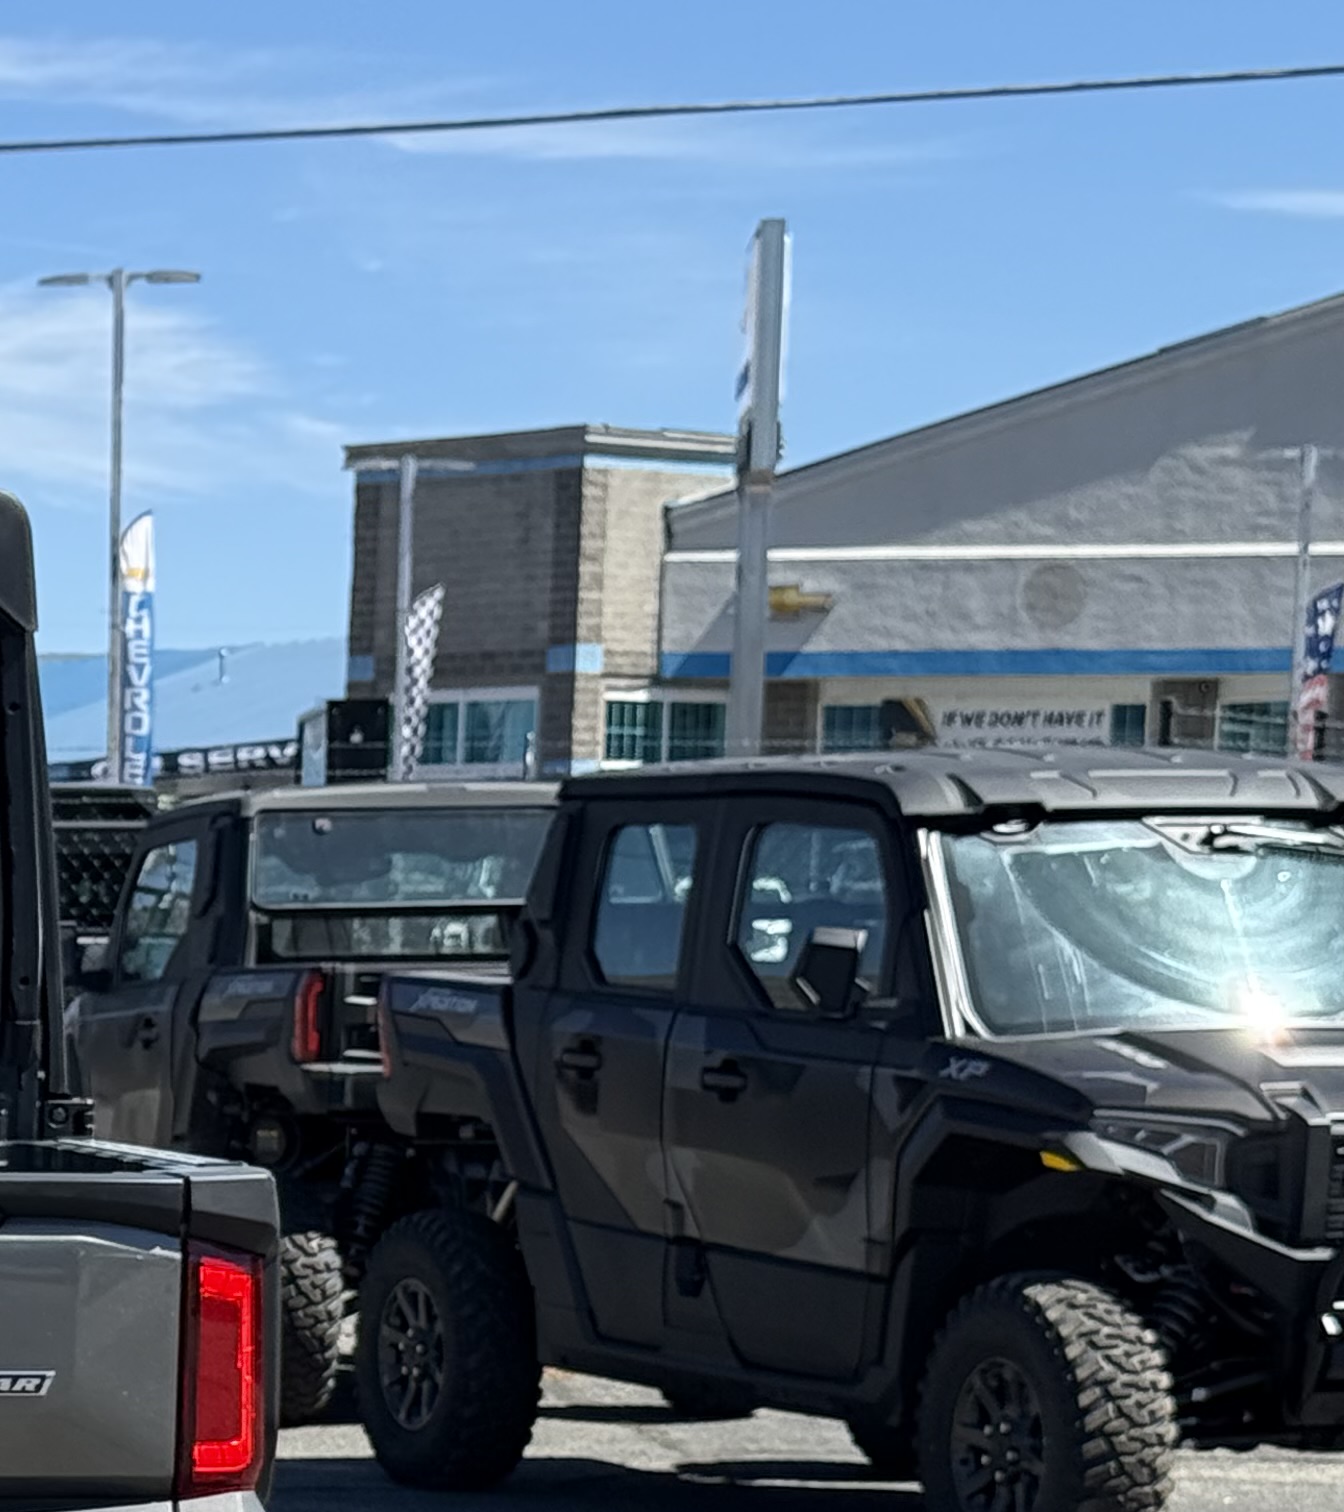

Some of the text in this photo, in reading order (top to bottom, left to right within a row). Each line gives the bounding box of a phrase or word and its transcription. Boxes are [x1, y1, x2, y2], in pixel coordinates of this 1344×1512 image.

[942, 709, 1106, 728] IF WE DON'T HAVE IT
